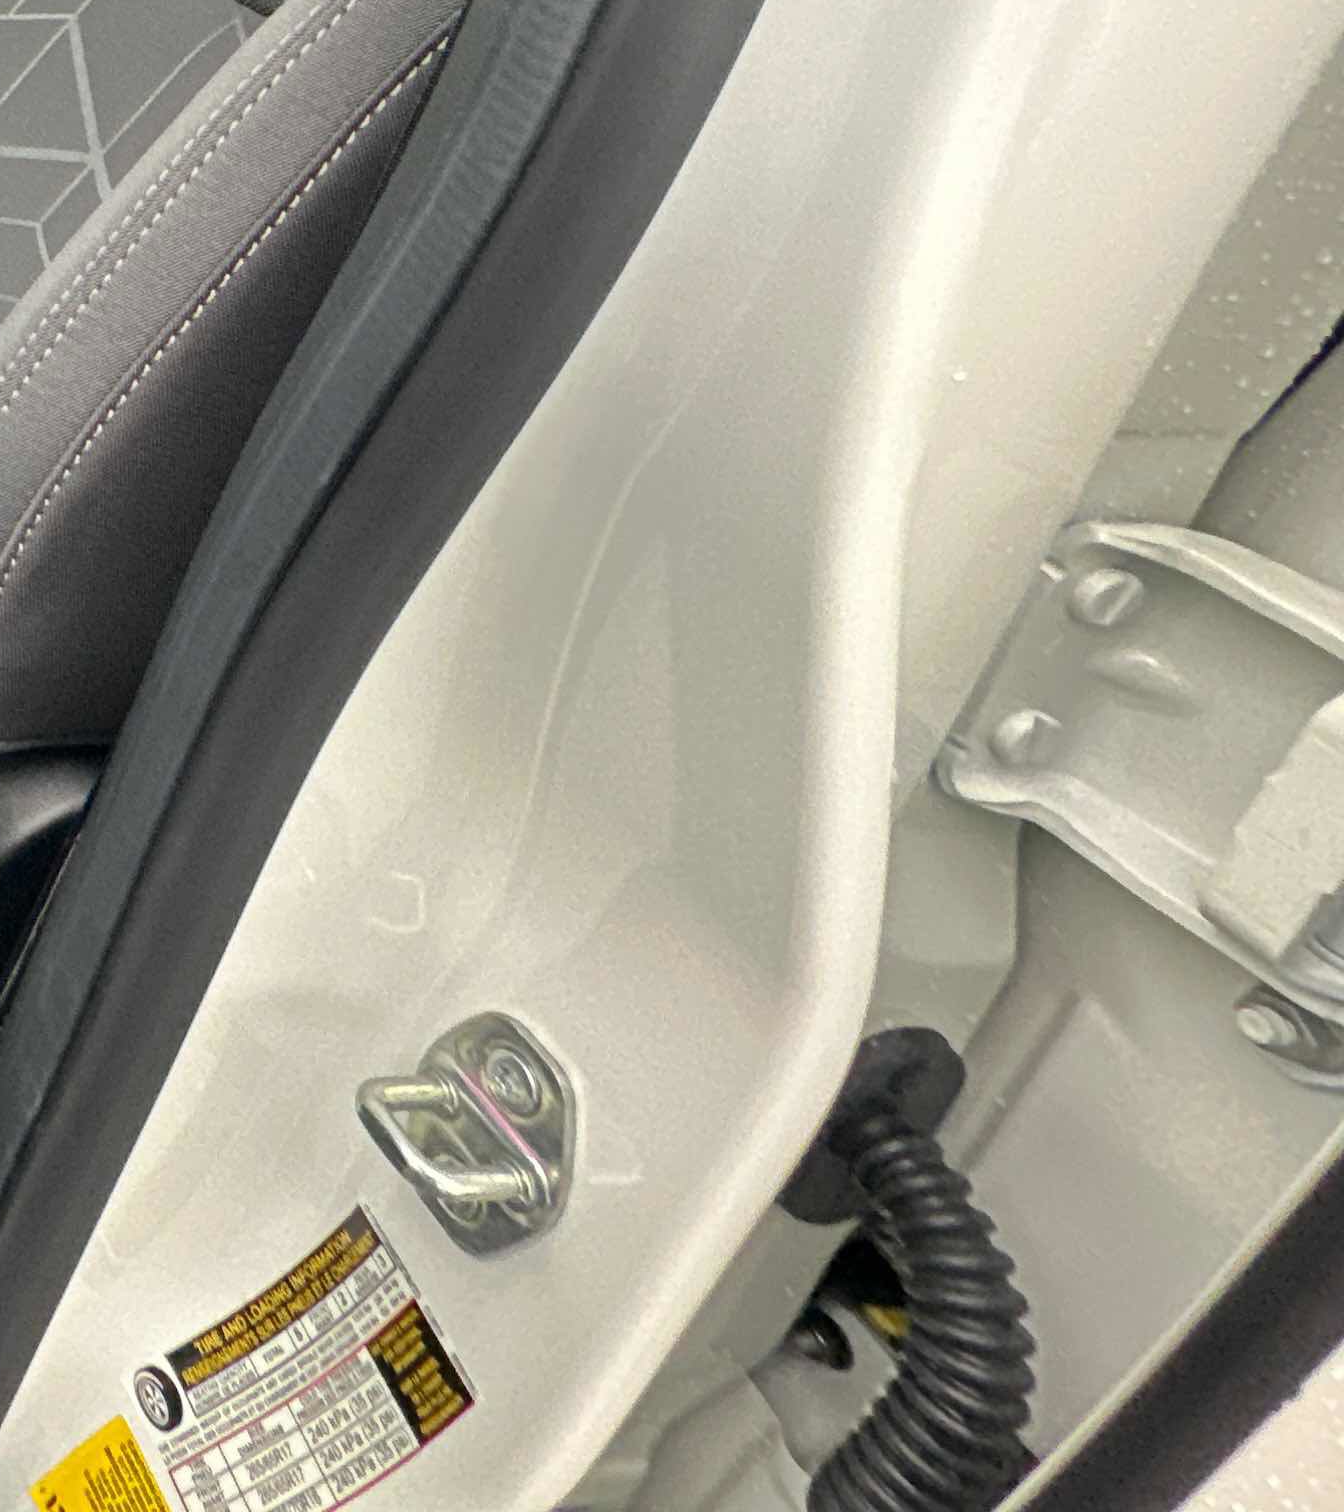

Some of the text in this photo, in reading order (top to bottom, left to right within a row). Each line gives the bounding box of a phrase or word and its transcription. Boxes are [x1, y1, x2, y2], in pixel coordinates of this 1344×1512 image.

[193, 1328, 225, 1356] TIRE
[219, 1312, 249, 1341] AND
[243, 1280, 295, 1325] LOADING
[287, 1227, 354, 1289] INFORMATION
[335, 1289, 349, 1306] 2
[306, 1418, 331, 1444] 240
[318, 1441, 343, 1468] 240
[330, 1465, 355, 1492] 240
